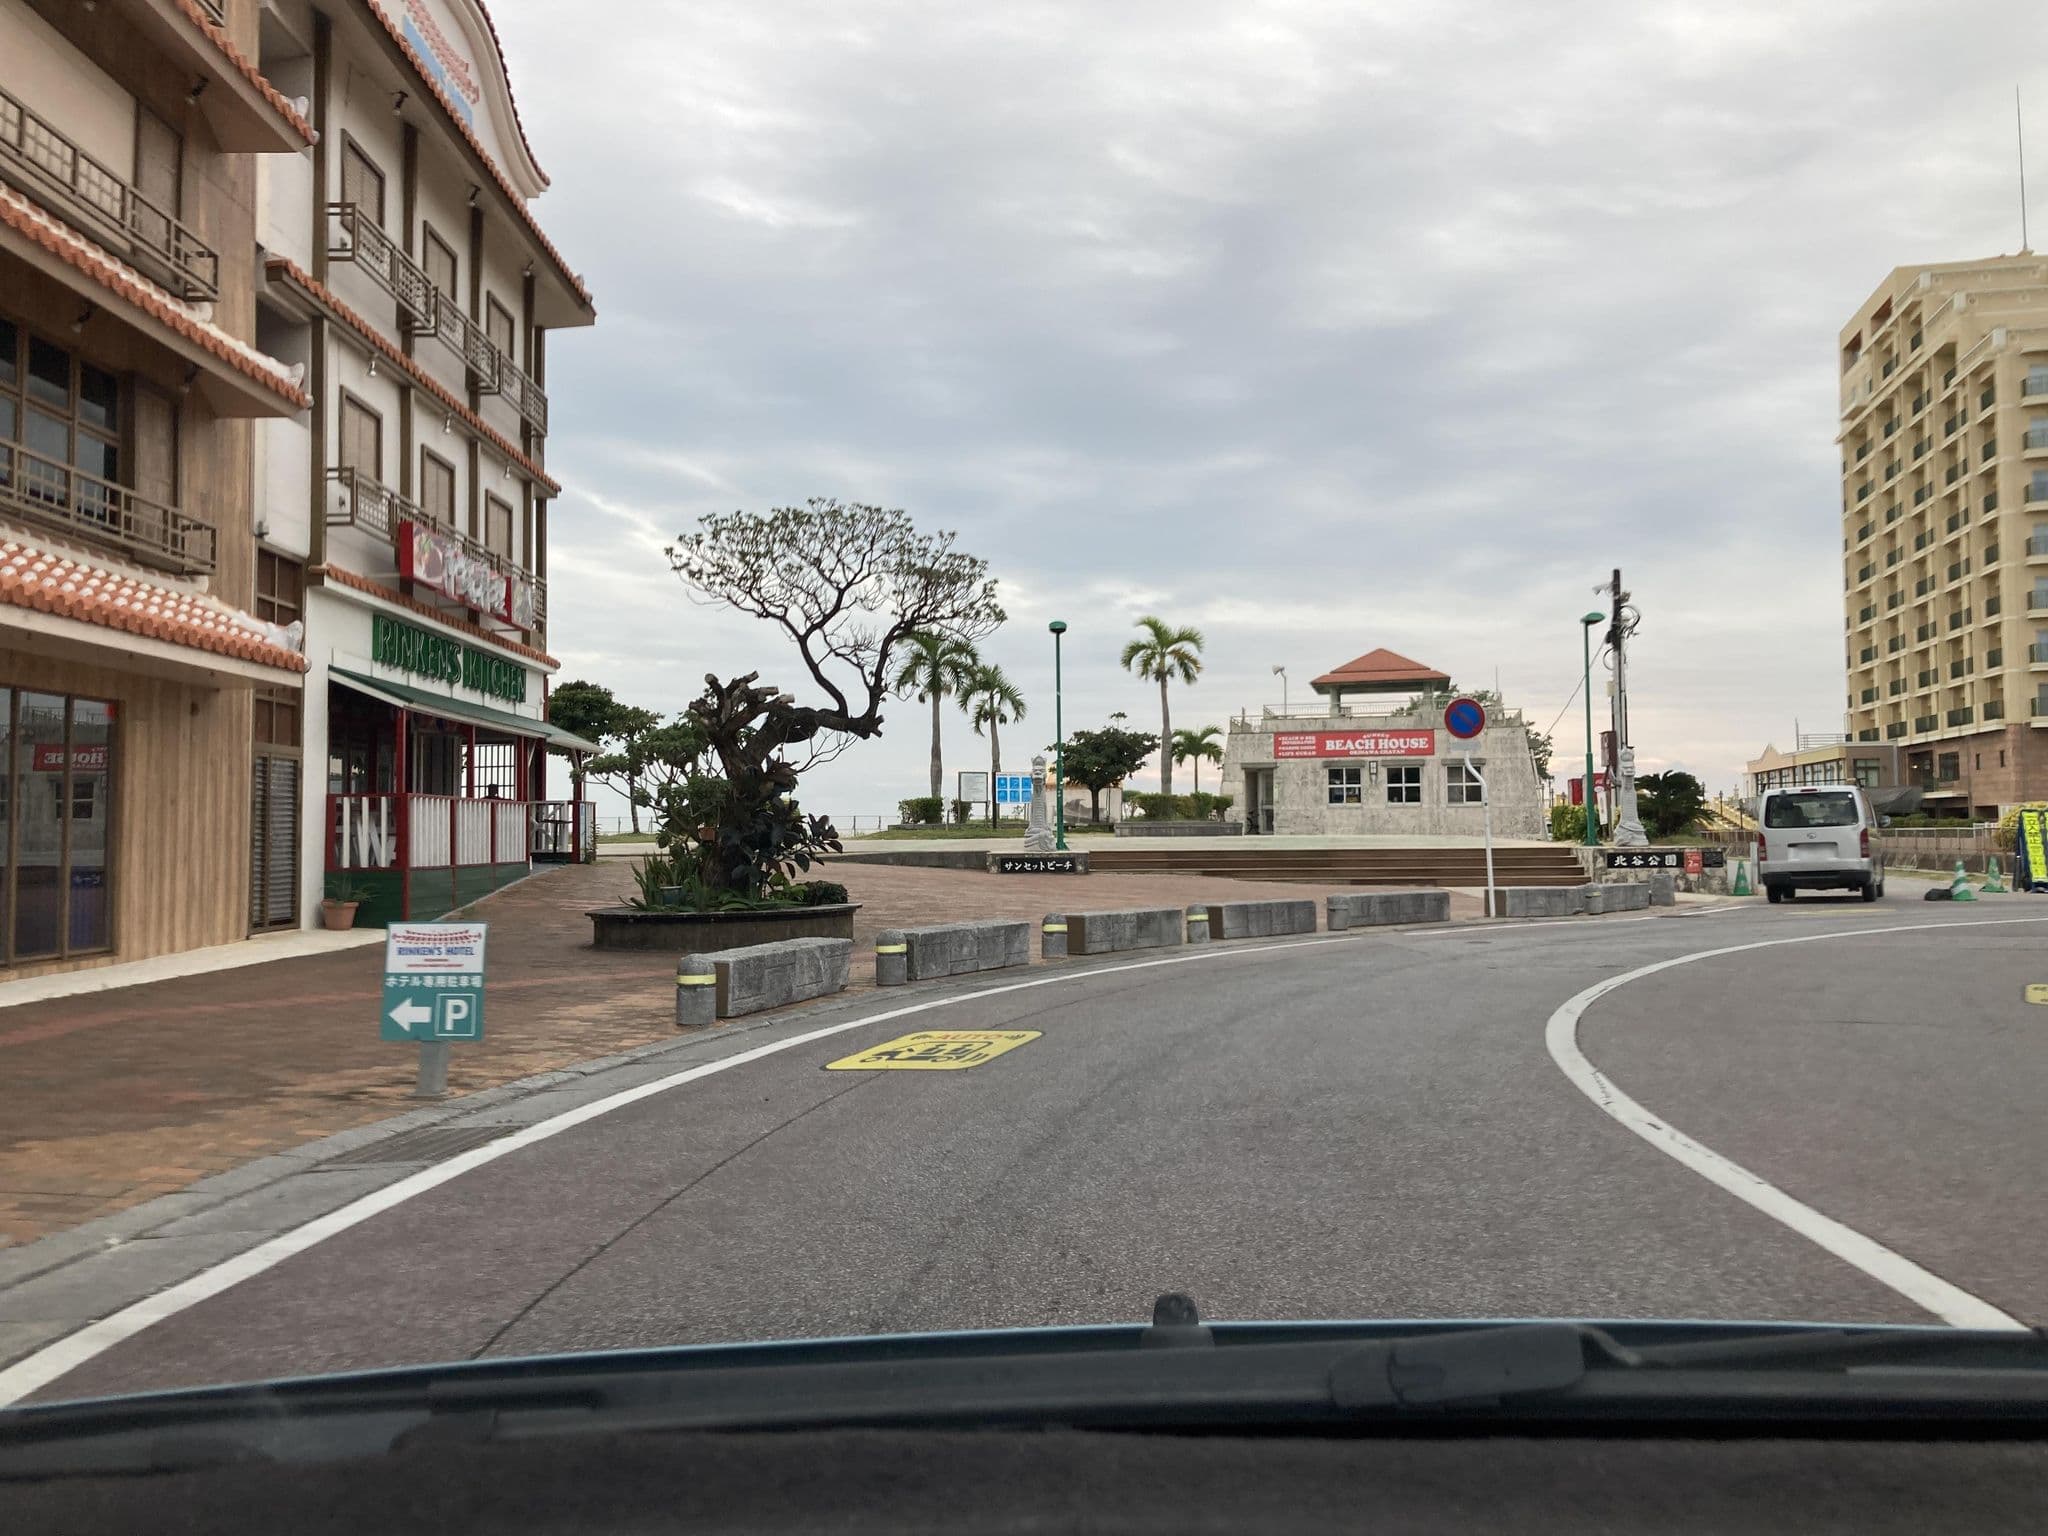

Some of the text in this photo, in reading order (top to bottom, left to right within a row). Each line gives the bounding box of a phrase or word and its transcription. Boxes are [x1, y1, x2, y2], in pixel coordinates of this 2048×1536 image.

[377, 616, 527, 703] RINKEN'S KITCHEN
[1325, 739, 1374, 750] BEACH
[1378, 737, 1429, 749] HOUSE
[1004, 860, 1073, 871] サンセットビーチ
[1614, 854, 1678, 866] 北谷公園
[446, 946, 475, 956] HOTEL
[445, 999, 469, 1031] P
